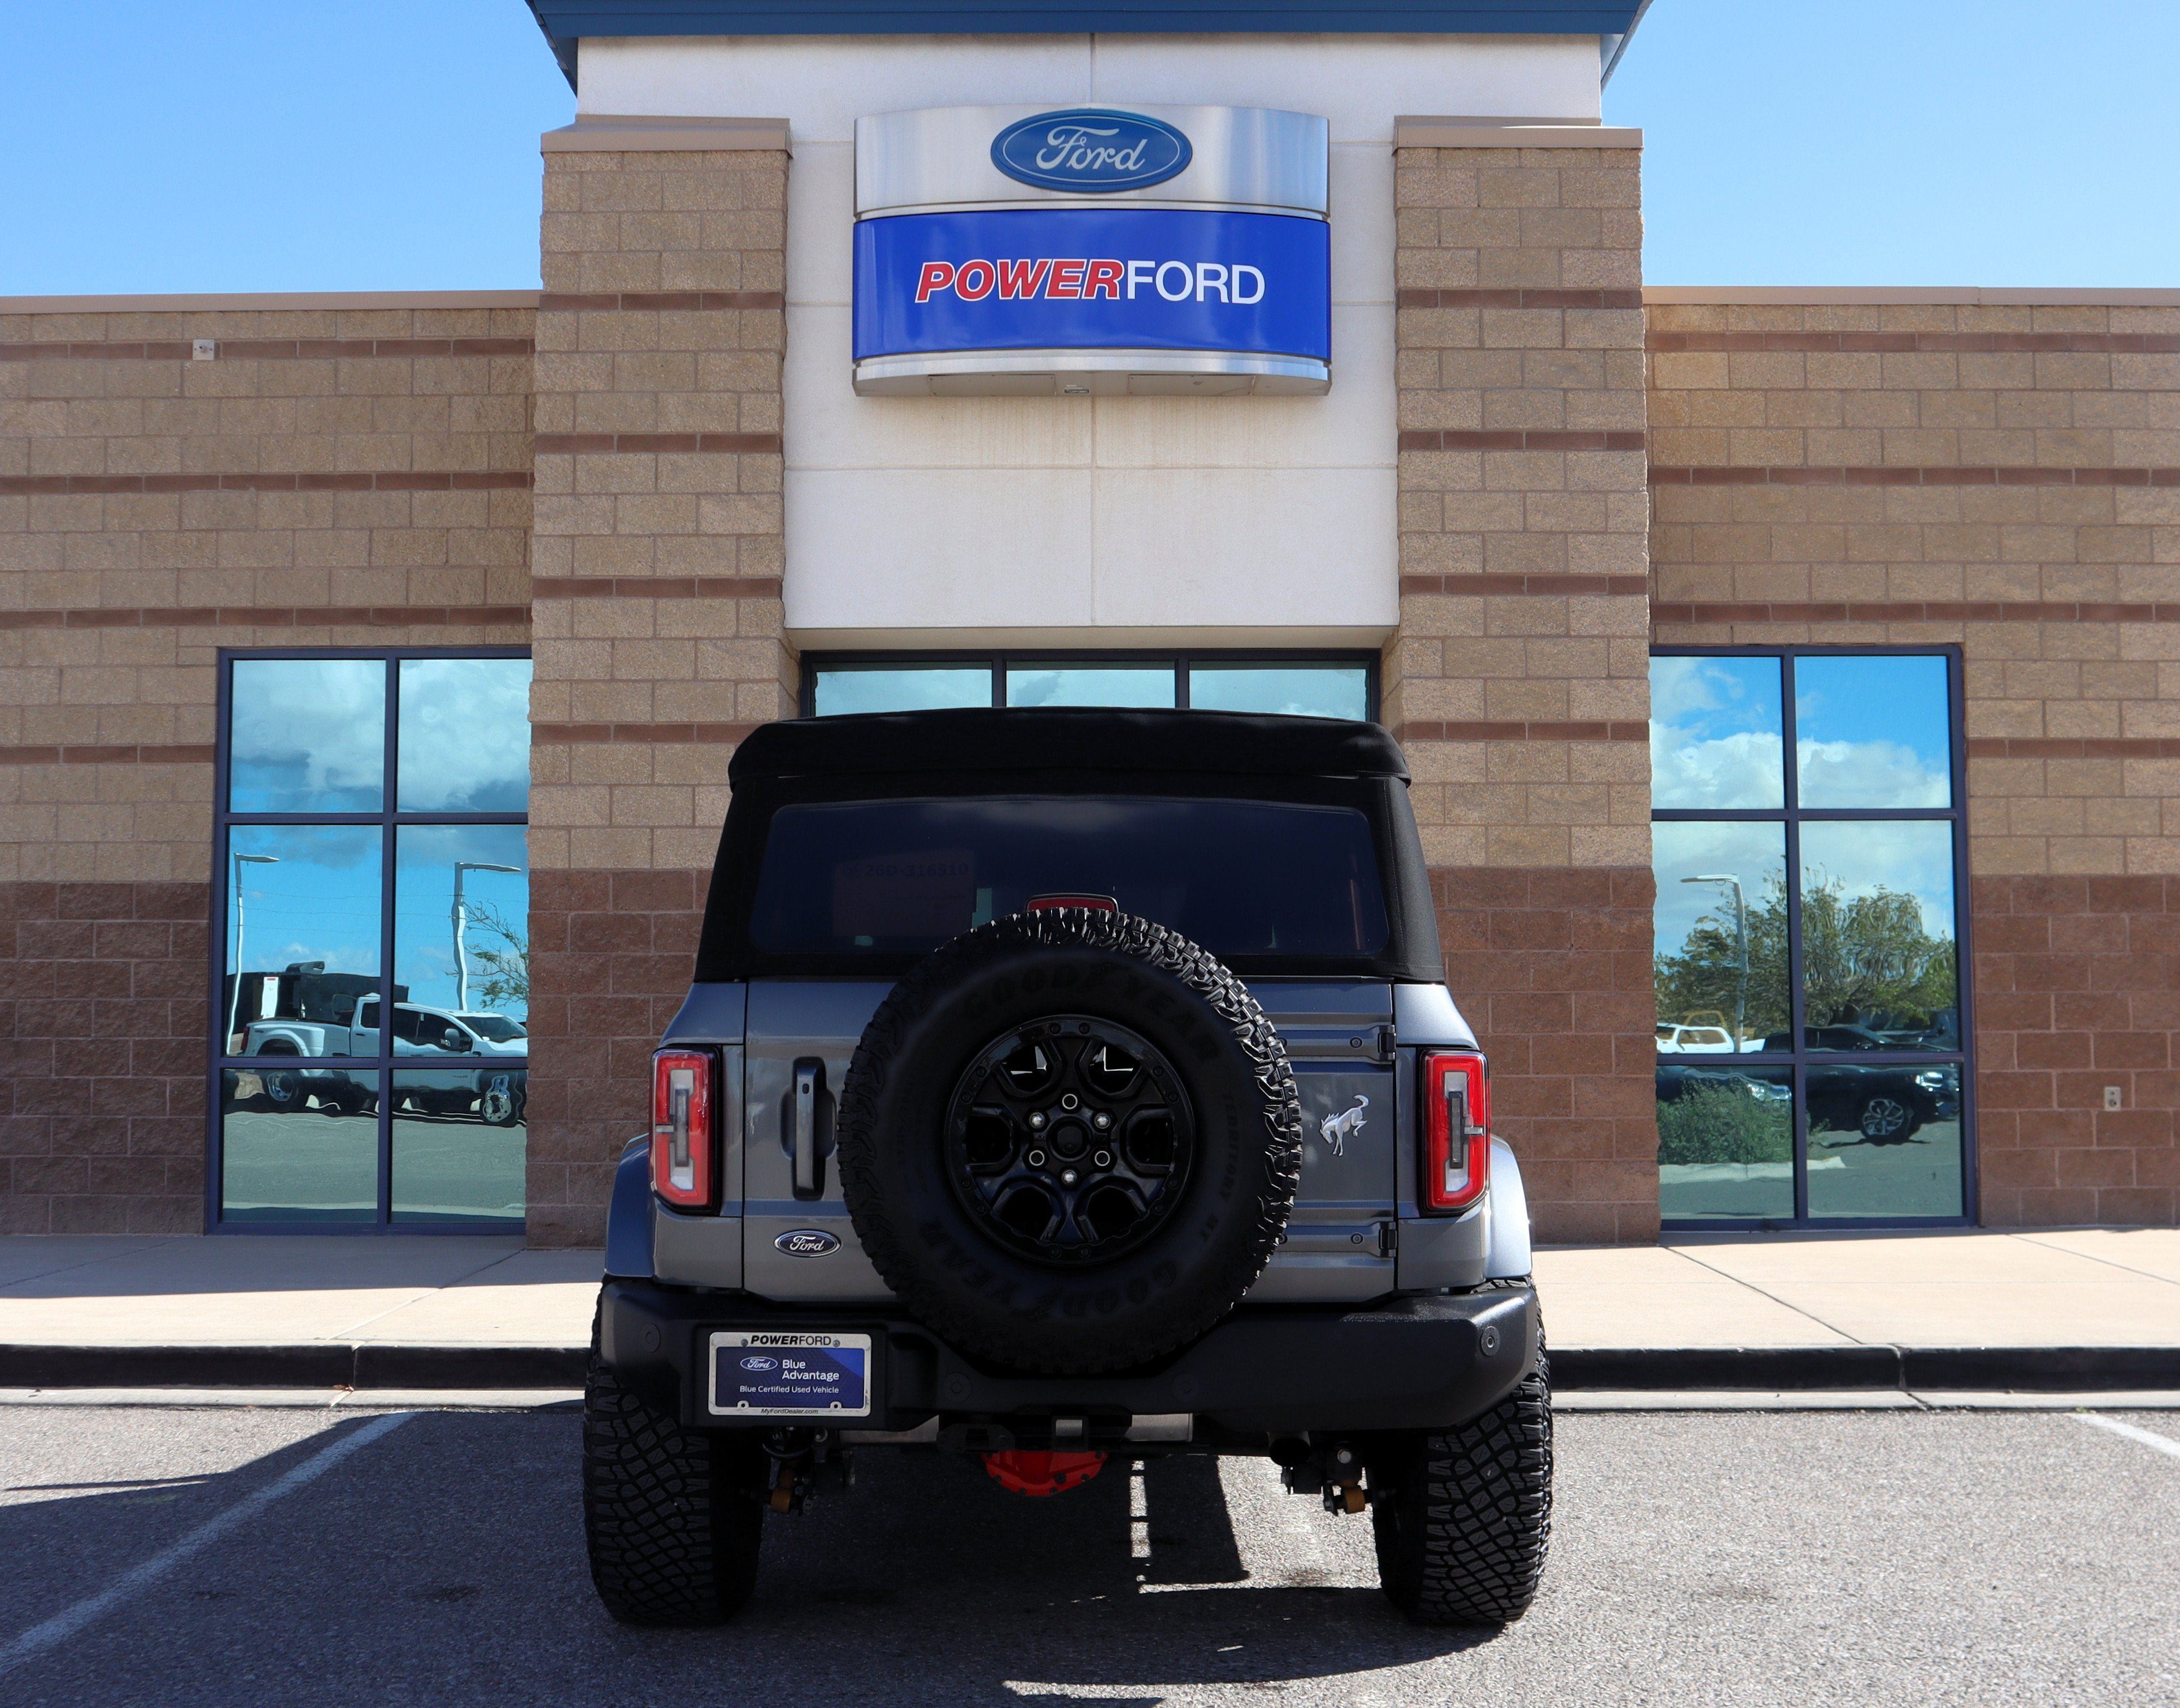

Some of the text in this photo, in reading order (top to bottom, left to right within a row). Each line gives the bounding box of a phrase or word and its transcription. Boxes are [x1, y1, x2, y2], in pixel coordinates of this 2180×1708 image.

[1036, 125, 1149, 172] Ford
[789, 1235, 825, 1251] Ford
[750, 1335, 832, 1345] POWERFORD
[747, 1359, 770, 1369] Ford
[782, 1360, 806, 1369] Blue
[782, 1370, 840, 1382] Advantage
